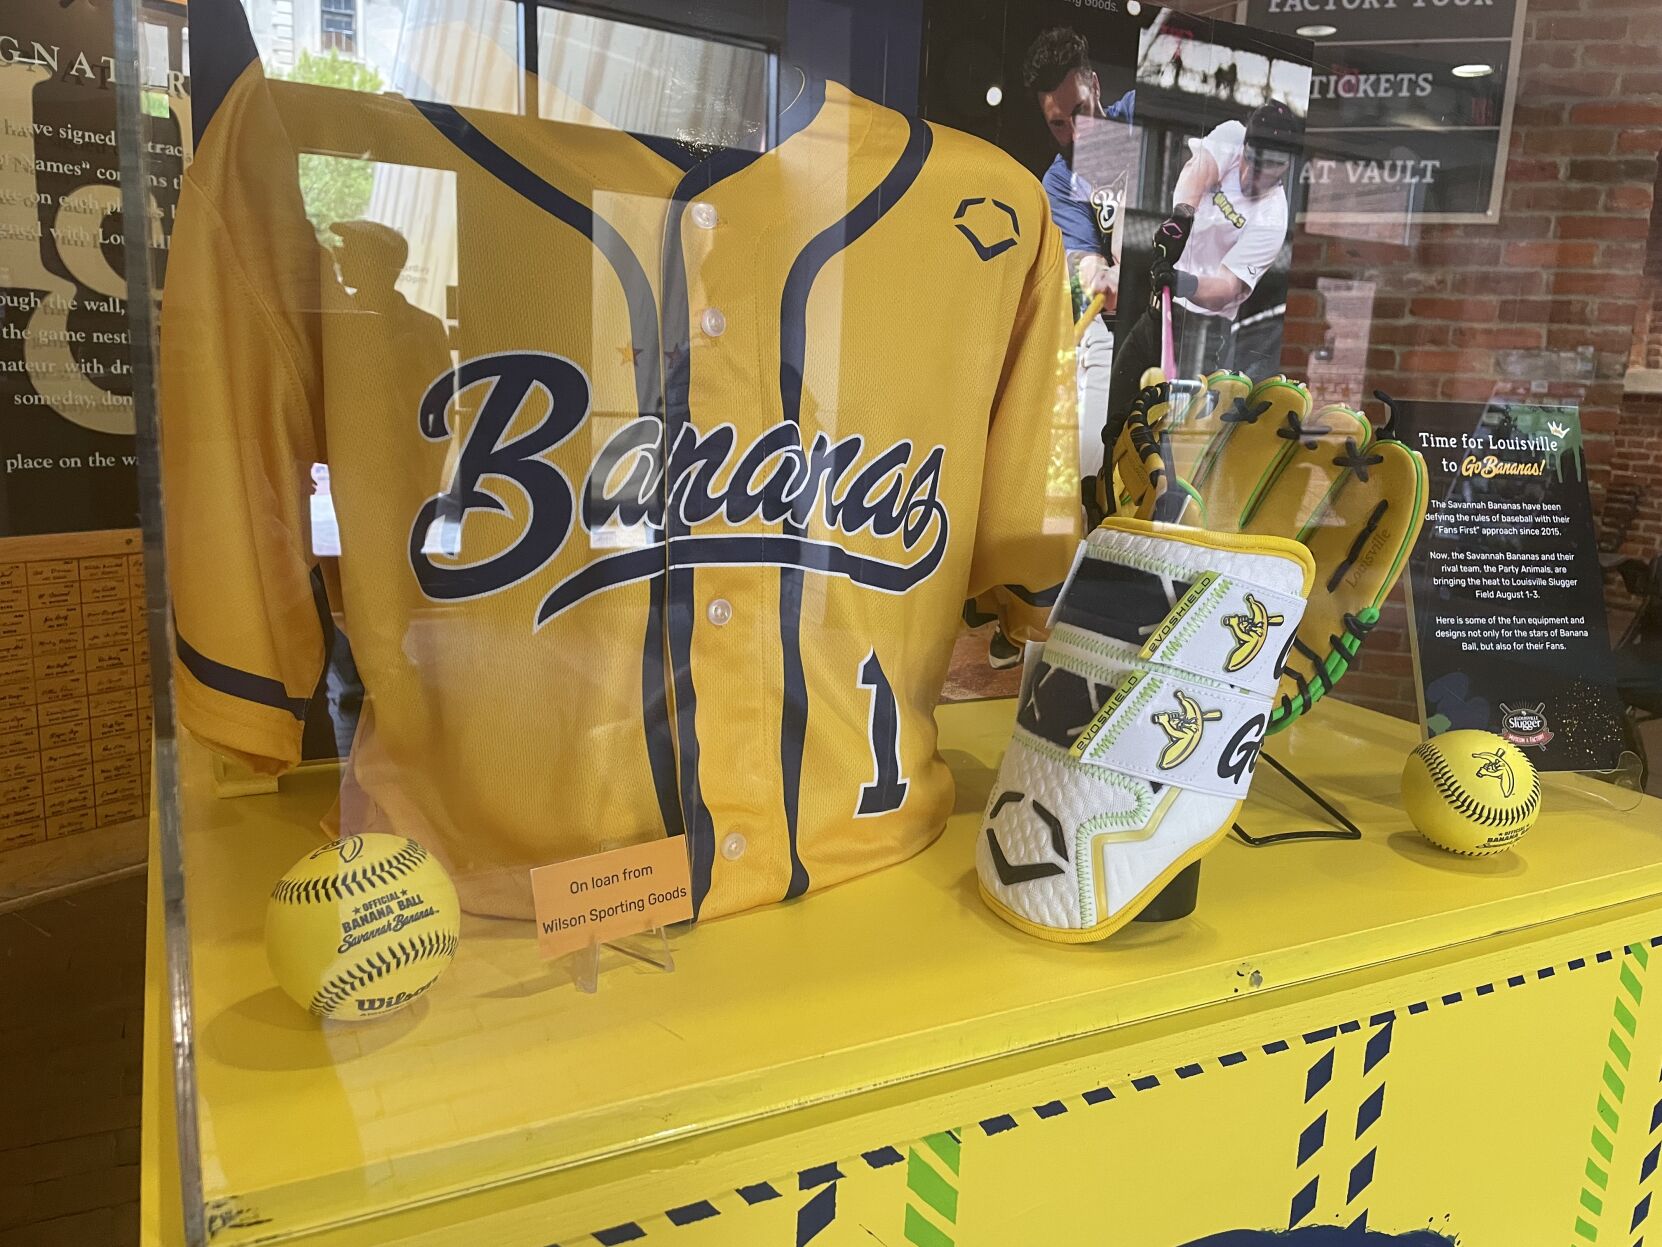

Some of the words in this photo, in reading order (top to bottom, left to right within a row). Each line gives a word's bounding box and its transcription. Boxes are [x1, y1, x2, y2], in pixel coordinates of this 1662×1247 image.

[1310, 73, 1433, 98] TICKETS
[59, 123, 117, 146] signed
[1345, 159, 1440, 184] VAULT
[50, 294, 77, 311] the
[84, 297, 125, 316] wall,
[2, 323, 32, 340] the
[38, 330, 86, 345] game
[66, 358, 104, 374] with
[14, 390, 96, 408] someday,
[1419, 433, 1457, 448] Time
[1462, 434, 1483, 448] for
[1488, 435, 1558, 451] Louisville
[6, 453, 53, 473] place
[59, 457, 82, 468] on
[88, 452, 116, 467] the
[1442, 458, 1457, 472] to
[408, 350, 949, 602] Bananas
[1431, 500, 1446, 509] The
[1448, 500, 1486, 510] Savannah
[1488, 501, 1520, 510] Bananas
[1522, 502, 1541, 511] have
[1542, 502, 1561, 511] been
[1425, 513, 1455, 523] defying
[1456, 513, 1469, 522] the
[1471, 514, 1490, 522] rules
[1491, 514, 1500, 522] of
[1501, 514, 1533, 523] baseball
[1534, 515, 1551, 523] with
[1552, 515, 1570, 524] their
[1481, 527, 1518, 536] approach
[1519, 527, 1540, 536] since
[1541, 527, 1562, 536] 2015.
[1345, 528, 1391, 588] Louisville
[1451, 551, 1465, 560] the
[1466, 552, 1505, 560] Savannah
[1506, 552, 1539, 561] Bananas
[1541, 552, 1555, 561] and
[1556, 552, 1575, 561] their
[1441, 564, 1458, 573] rival
[1483, 565, 1497, 573] the
[1498, 565, 1519, 574] Party
[1433, 577, 1467, 587] bringing
[1467, 577, 1481, 586] the
[1482, 577, 1500, 586] heat
[1501, 578, 1510, 586] to
[1511, 577, 1547, 586] Louisville
[1548, 578, 1577, 588] Slugger
[1475, 590, 1494, 599] Field
[1496, 590, 1524, 600] August
[1525, 590, 1541, 599] 1-3.
[1436, 616, 1456, 624] Here
[1456, 616, 1464, 624] is
[1487, 616, 1496, 624] of
[1497, 616, 1511, 624] the
[1513, 616, 1526, 624] fun
[1527, 616, 1569, 626] equipment
[1570, 616, 1585, 624] and
[1435, 630, 1466, 639] designs
[1467, 630, 1481, 638] not
[1483, 629, 1500, 639] only
[1501, 629, 1513, 637] for
[1514, 629, 1528, 637] the
[1550, 629, 1558, 637] of
[1559, 629, 1589, 637] Banana
[1461, 642, 1479, 651] Ball,
[1480, 642, 1494, 650] but
[1495, 642, 1512, 650] also
[1512, 642, 1524, 650] for
[1525, 642, 1544, 650] their
[1545, 642, 1567, 650] Fans.
[853, 643, 910, 818] 1
[1508, 717, 1541, 731] Slugger
[570, 881, 588, 894] On
[592, 873, 619, 889] loan
[623, 865, 653, 881] from
[362, 891, 400, 912] OFFICIAL
[543, 914, 586, 934] Wilson
[590, 898, 645, 922] Sporting
[648, 887, 687, 906] Goods
[342, 904, 394, 934] BANANA
[397, 894, 424, 912] BALL
[337, 919, 394, 954] Savannah
